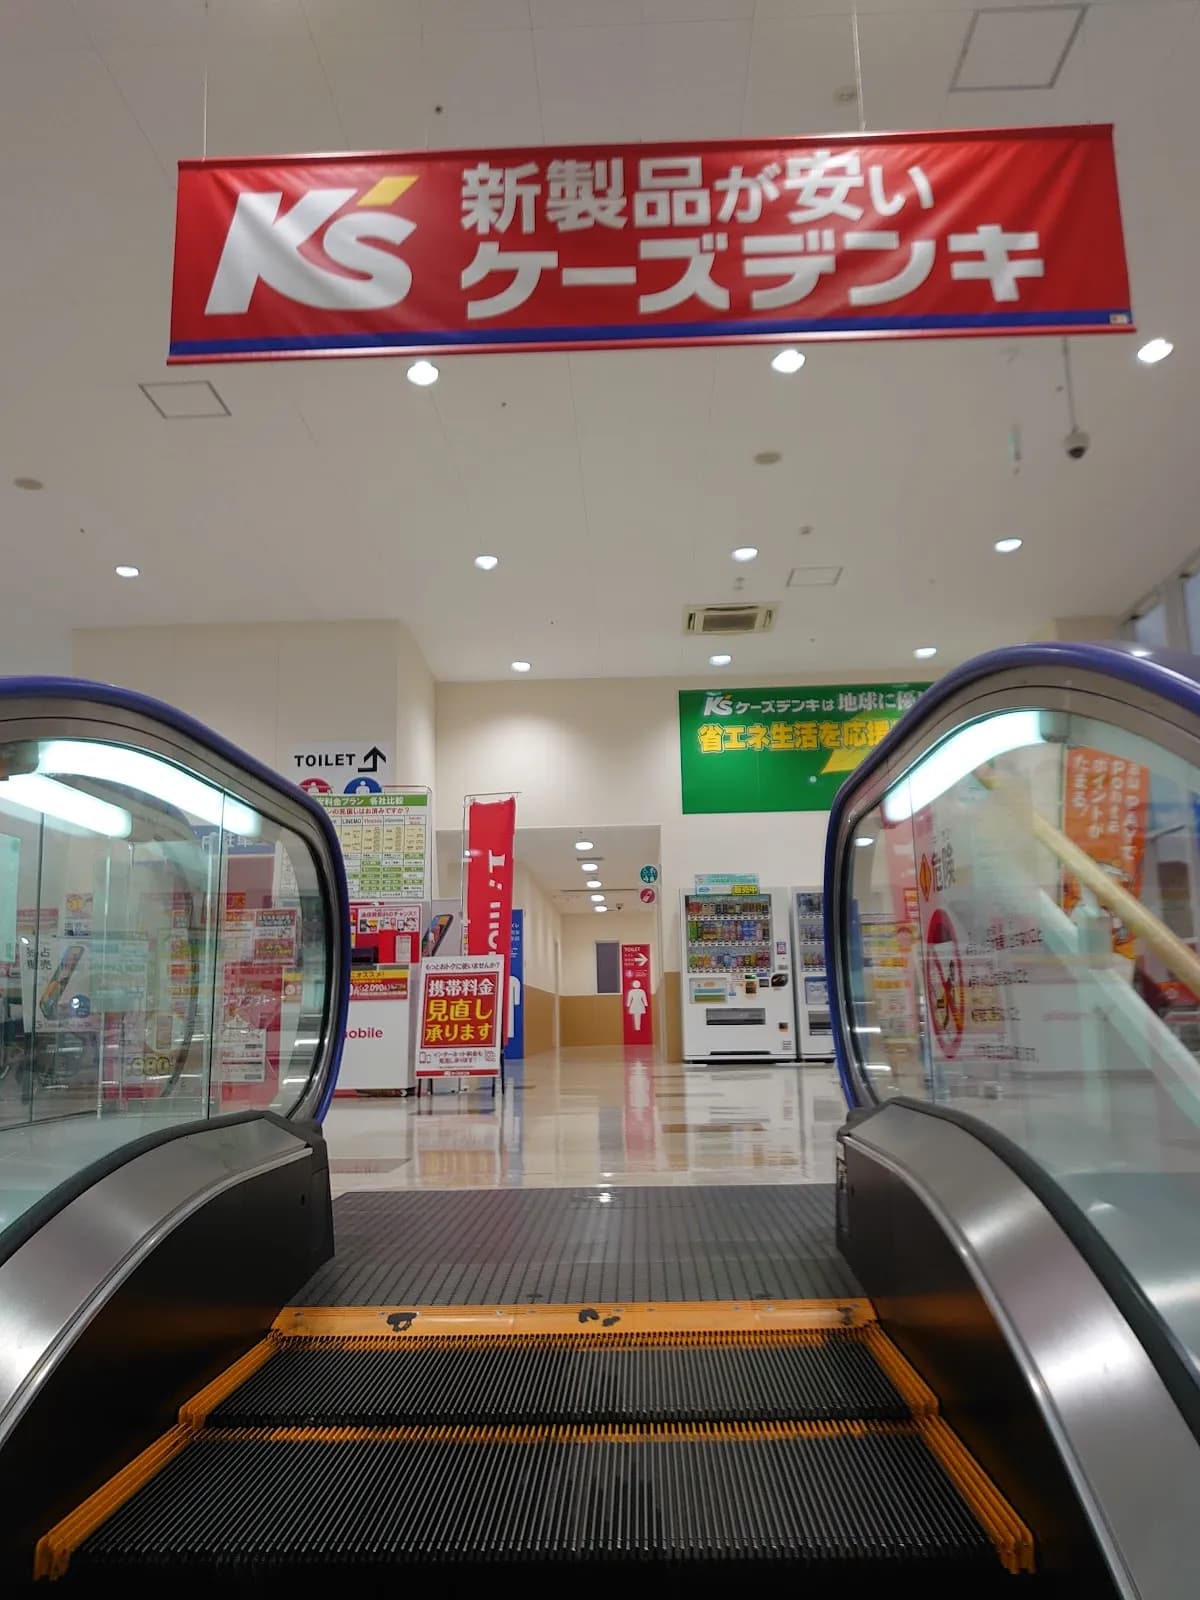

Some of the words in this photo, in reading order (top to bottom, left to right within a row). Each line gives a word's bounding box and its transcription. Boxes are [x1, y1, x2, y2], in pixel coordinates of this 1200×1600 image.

[461, 147, 934, 236] 新製品が安い
[460, 223, 1046, 319] ケーズデンキ
[735, 697, 834, 715] ケーズデンキは
[697, 718, 898, 754] 省エネ生活を応援
[293, 751, 357, 768] TOILET
[428, 978, 495, 997] 携帯料金
[426, 998, 493, 1022] 見直し
[425, 1023, 493, 1043] 承ります
